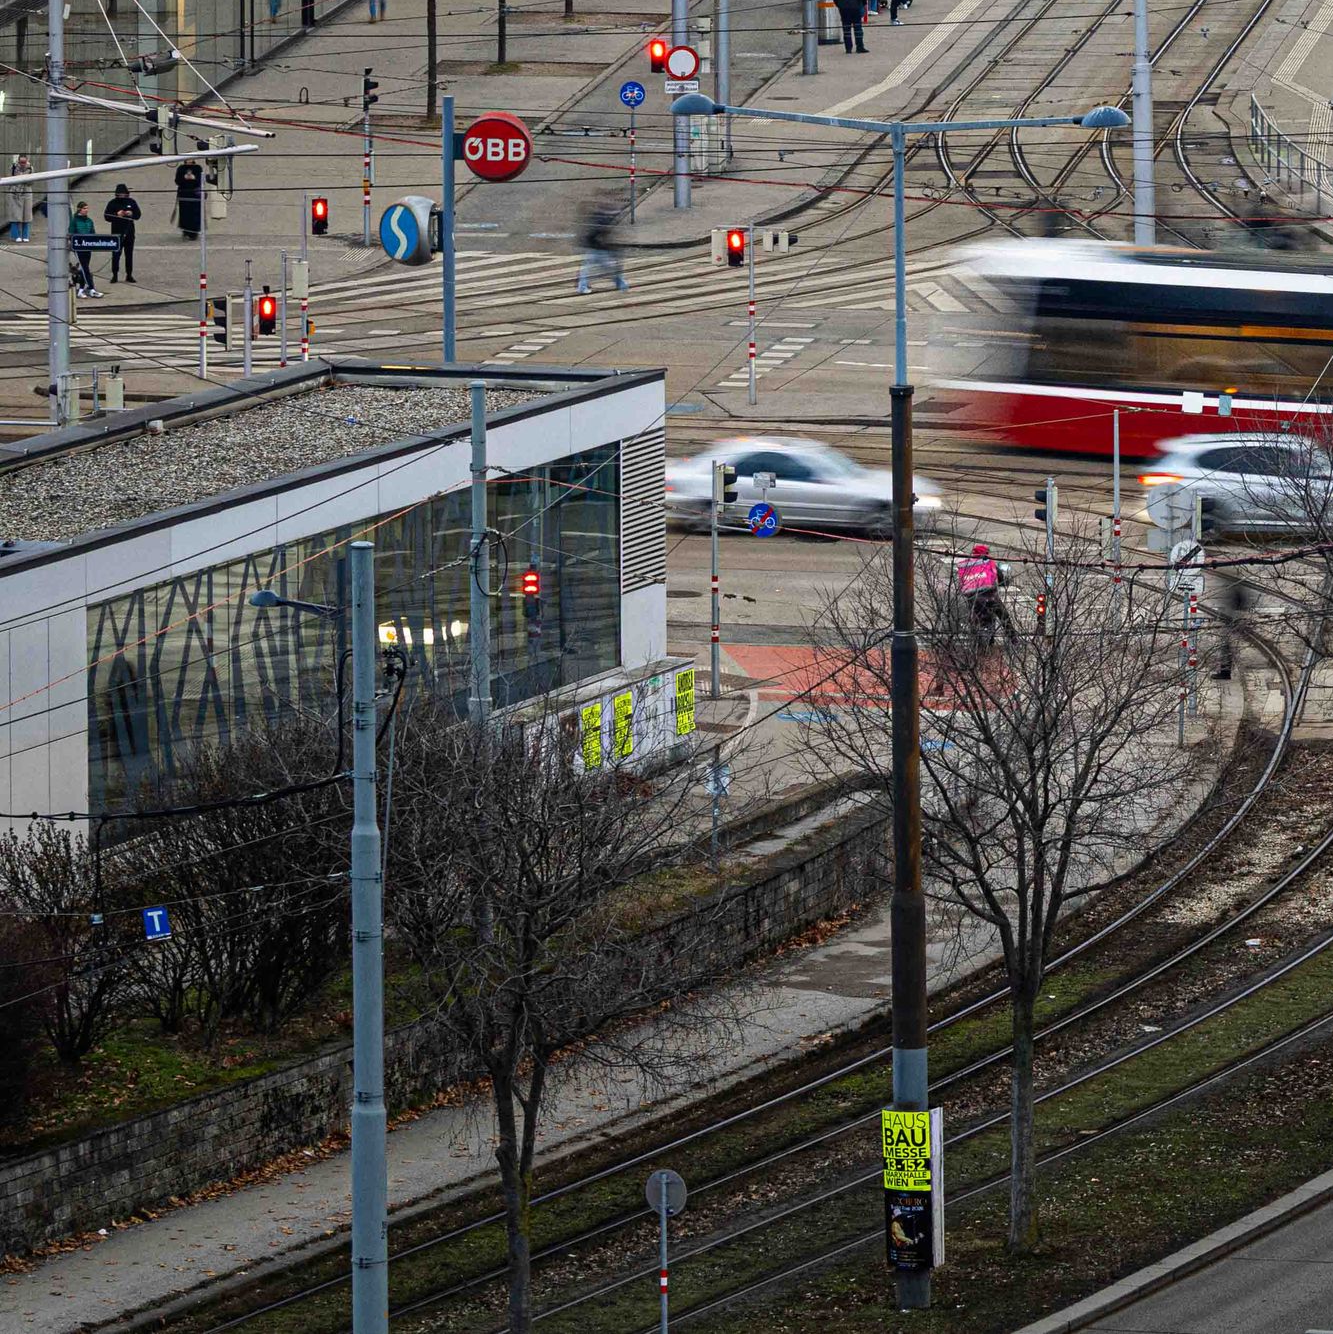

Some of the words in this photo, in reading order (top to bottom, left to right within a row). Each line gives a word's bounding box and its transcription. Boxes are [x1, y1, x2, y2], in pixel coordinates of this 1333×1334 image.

[464, 136, 526, 162] ÖBB
[147, 911, 162, 932] T
[884, 1113, 926, 1129] HAUS
[885, 1128, 926, 1146] BAU
[885, 1147, 927, 1158] MESSE
[886, 1177, 908, 1187] WIEN
